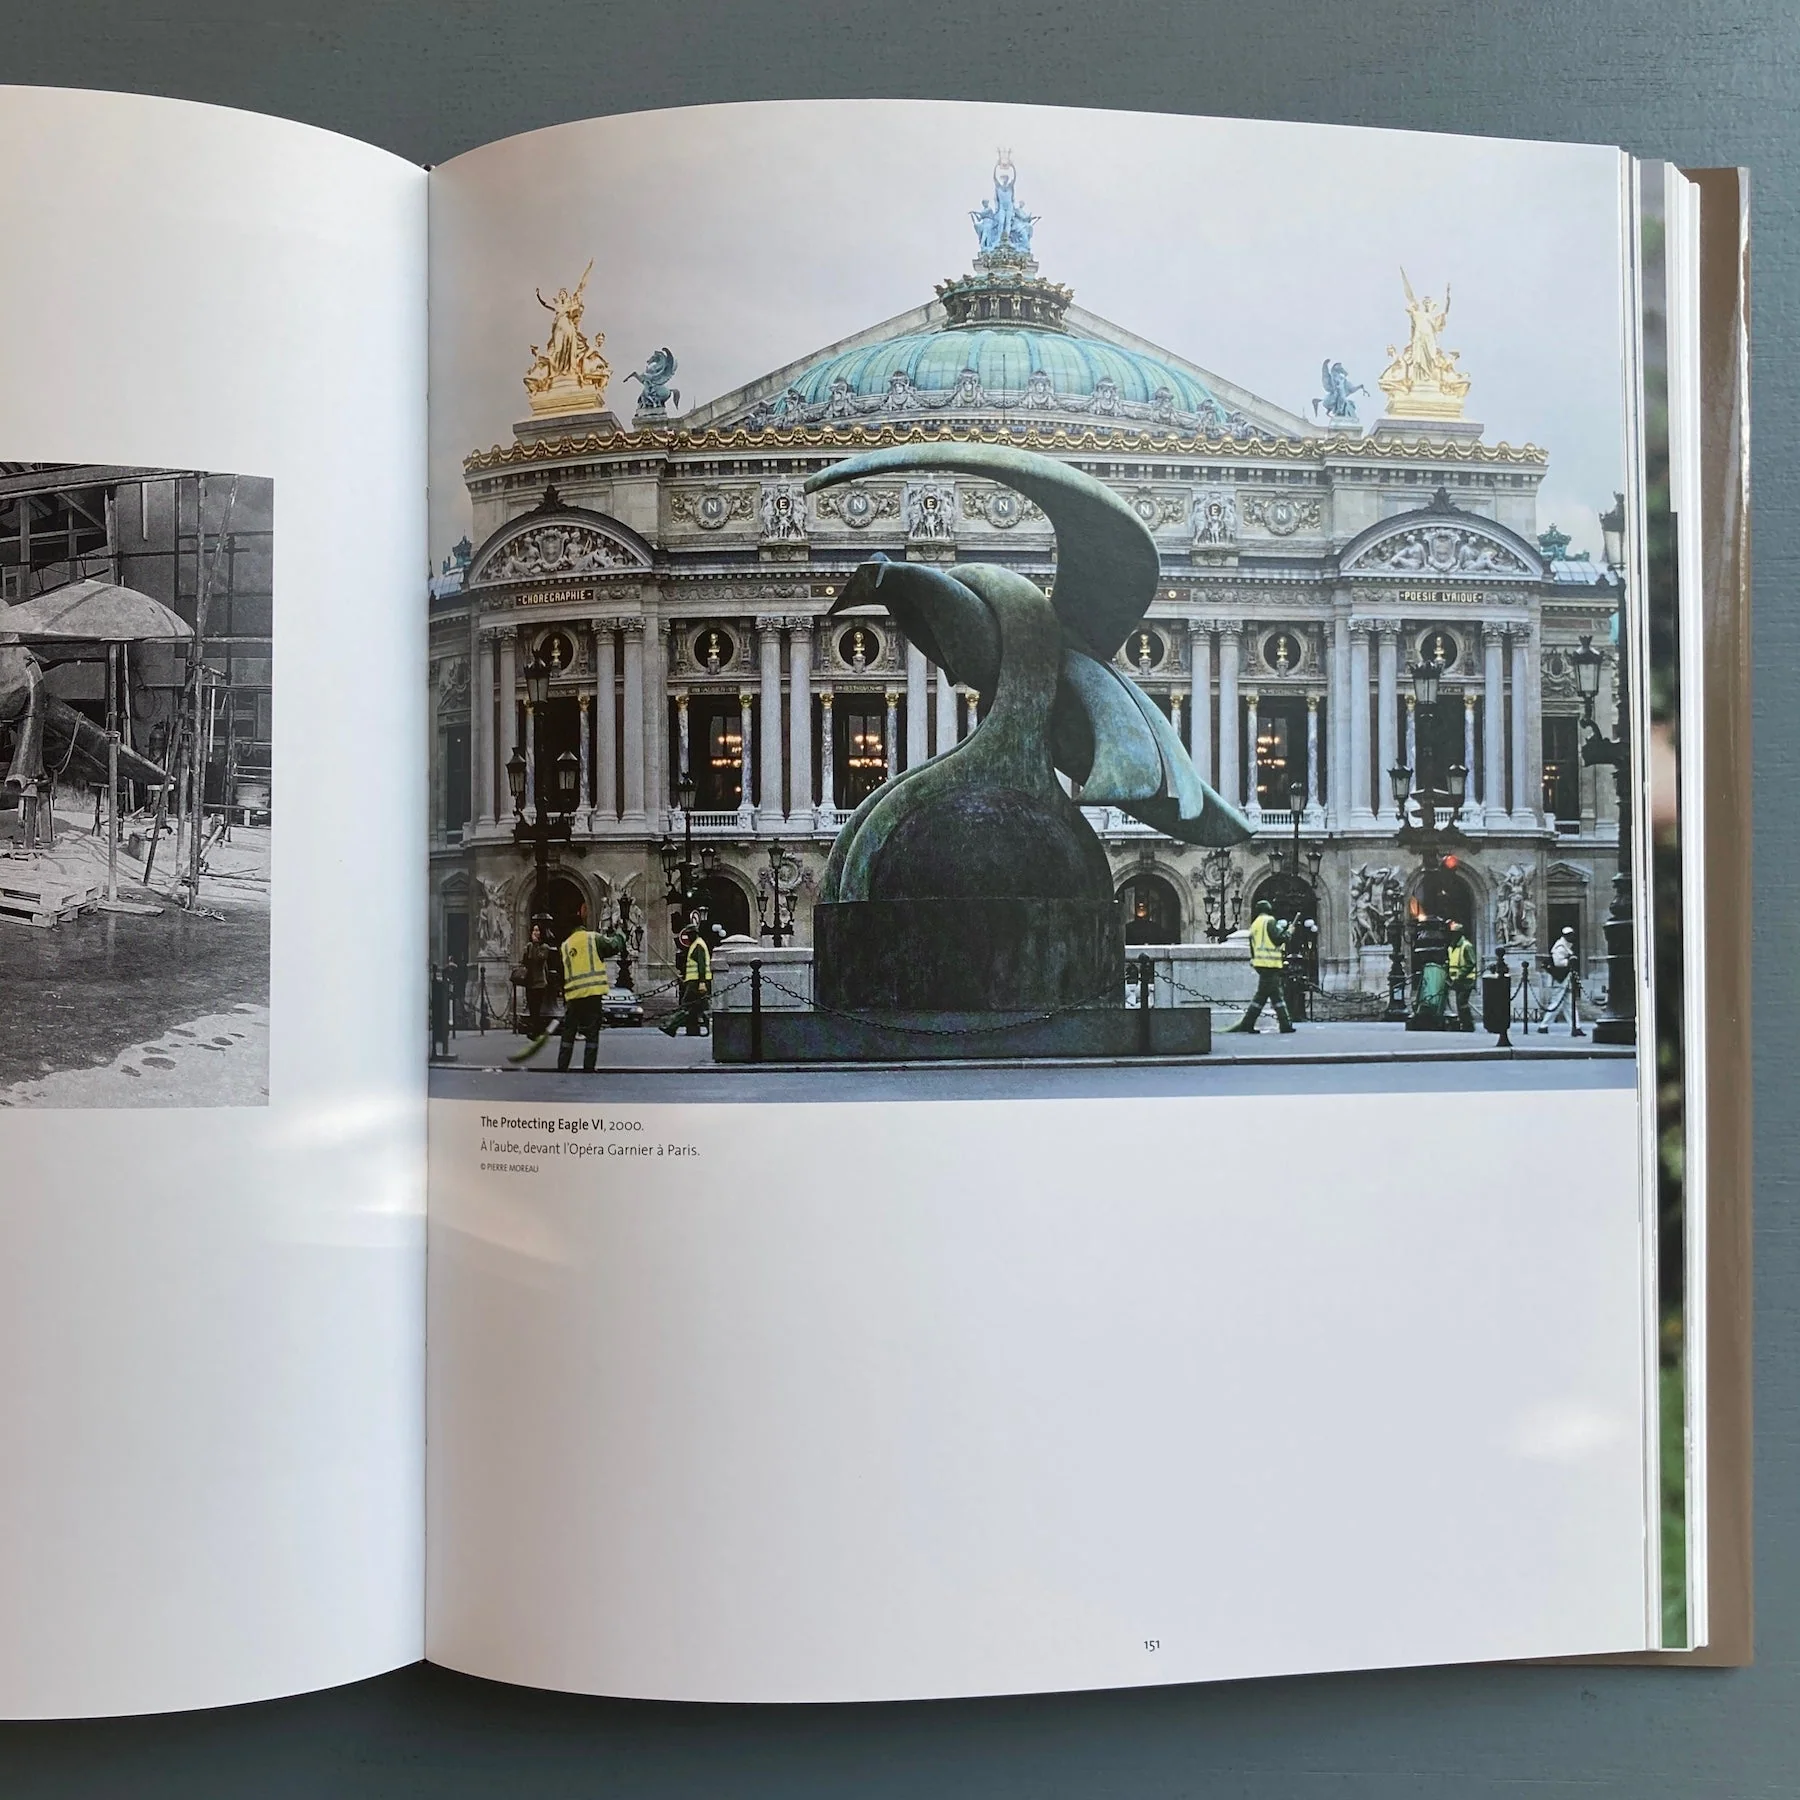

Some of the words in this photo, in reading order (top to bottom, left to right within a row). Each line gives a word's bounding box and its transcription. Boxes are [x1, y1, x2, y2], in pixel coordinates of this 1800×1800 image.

[707, 501, 717, 513] N
[779, 499, 787, 509] E
[853, 499, 865, 510] N
[926, 499, 935, 508] E
[999, 500, 1009, 512] N
[1140, 504, 1149, 515] N
[1210, 505, 1219, 515] E
[1276, 508, 1287, 519] N
[522, 590, 586, 605] CHOREGRAPHIE
[1404, 591, 1437, 602] POESIE
[1442, 592, 1478, 603] LYRIQUE
[481, 1116, 498, 1128] The
[501, 1117, 555, 1133] Protecting
[558, 1118, 589, 1133] Eagle
[591, 1119, 607, 1132] VI,
[609, 1121, 644, 1131] 2000.
[490, 1140, 521, 1154] l'aube,
[523, 1141, 560, 1154] devant
[564, 1142, 604, 1158] l'Opéra
[608, 1143, 653, 1156] Garnier
[657, 1144, 664, 1156] à
[668, 1144, 700, 1156] Paris.
[487, 1163, 507, 1172] PIERRE
[509, 1164, 539, 1173] MOREAU
[1143, 1640, 1160, 1652] 151
